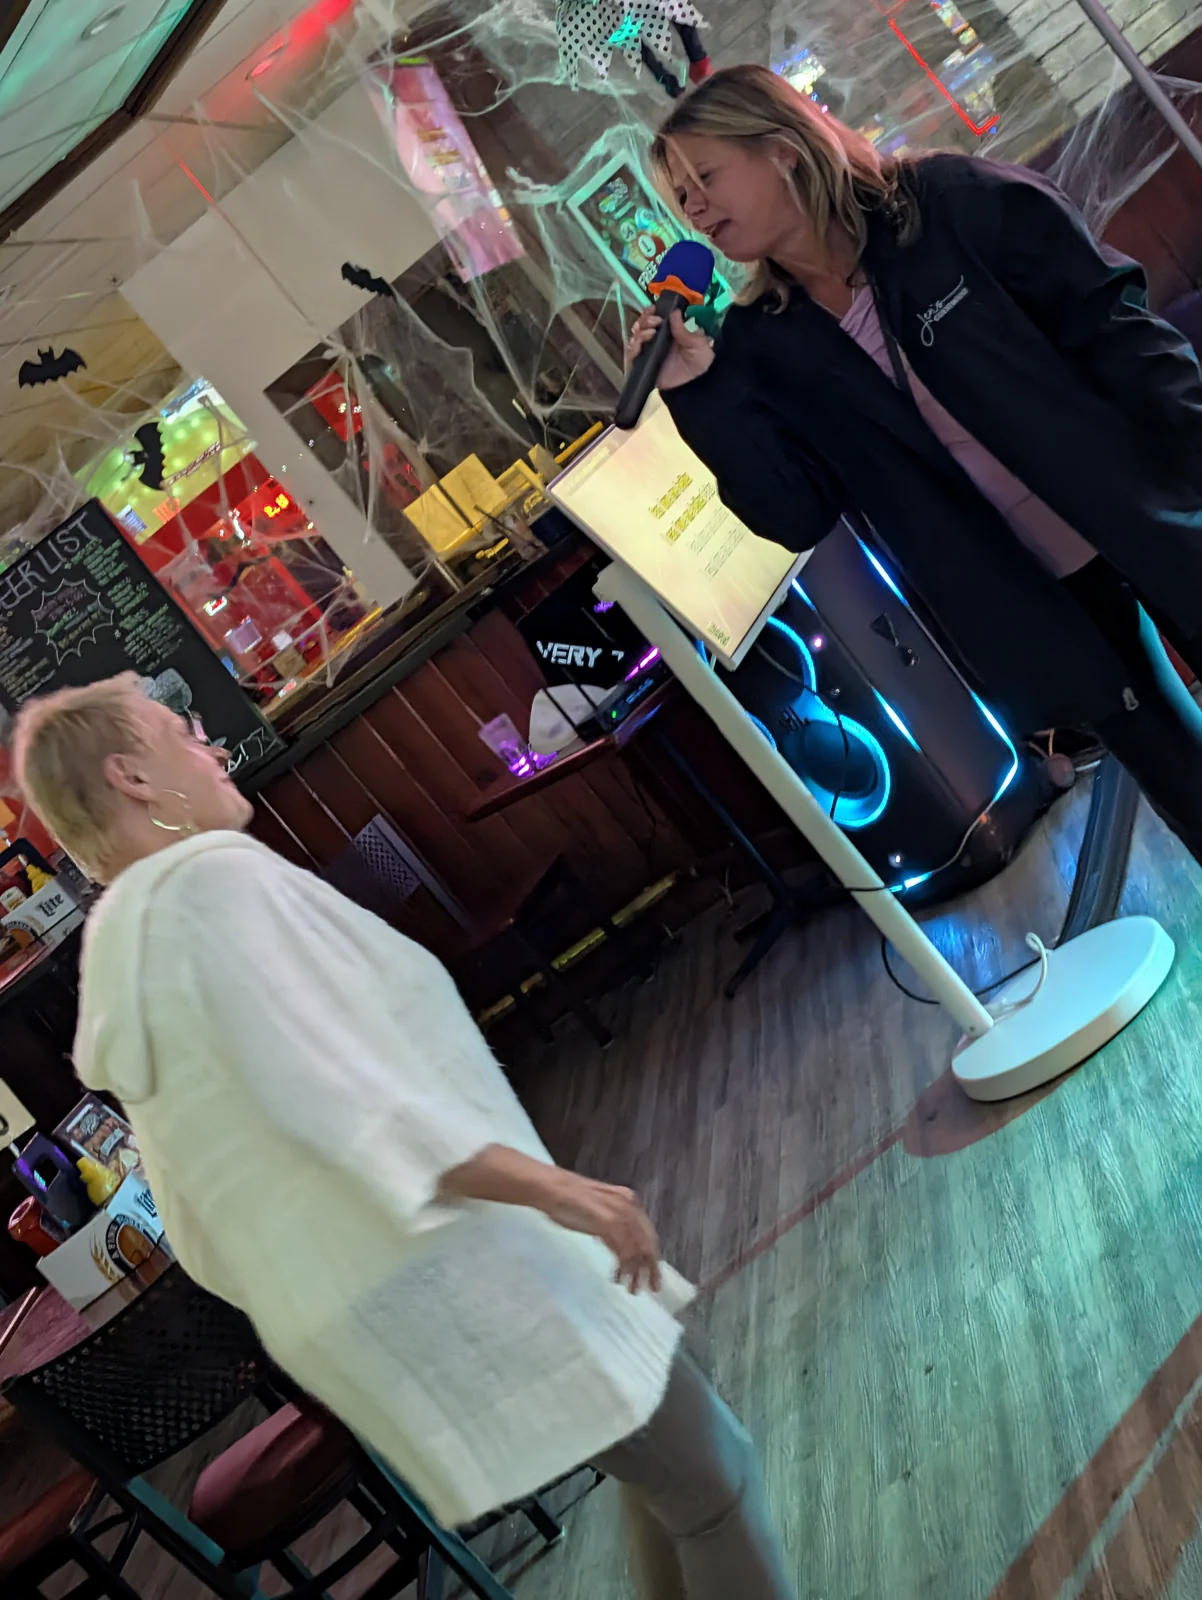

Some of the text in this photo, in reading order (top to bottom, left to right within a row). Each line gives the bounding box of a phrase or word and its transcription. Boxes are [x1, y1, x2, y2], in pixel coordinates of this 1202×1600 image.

[638, 261, 658, 291] FREE
[0, 560, 47, 609] EER
[35, 511, 99, 575] LIST
[536, 640, 602, 668] VERY
[38, 893, 64, 917] Lite
